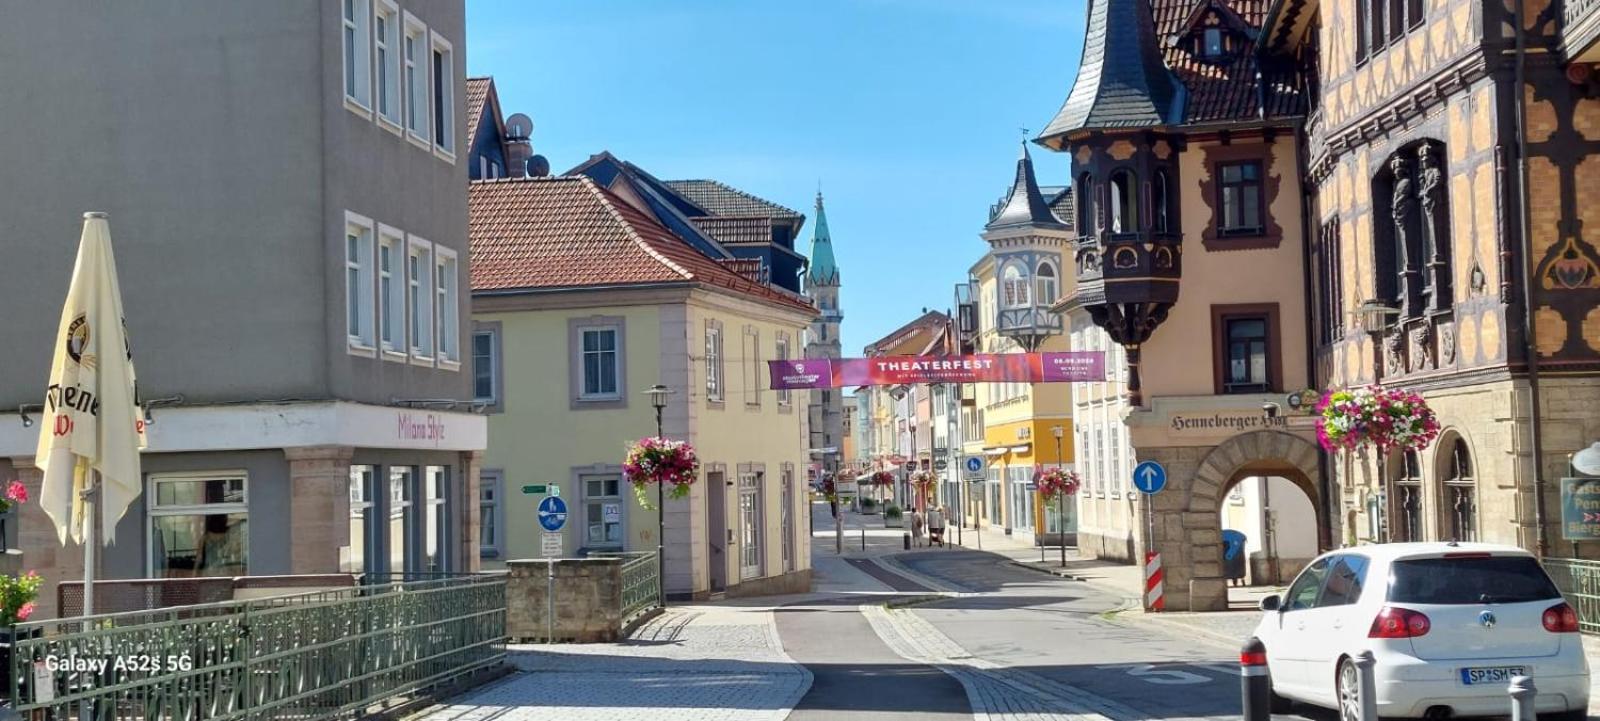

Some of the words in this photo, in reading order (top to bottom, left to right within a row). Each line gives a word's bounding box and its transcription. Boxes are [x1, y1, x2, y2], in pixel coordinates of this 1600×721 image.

[877, 360, 993, 372] THEATERFEST
[1171, 415, 1258, 431] Henneberger
[1470, 670, 1485, 682] SP
[1493, 669, 1507, 681] SM
